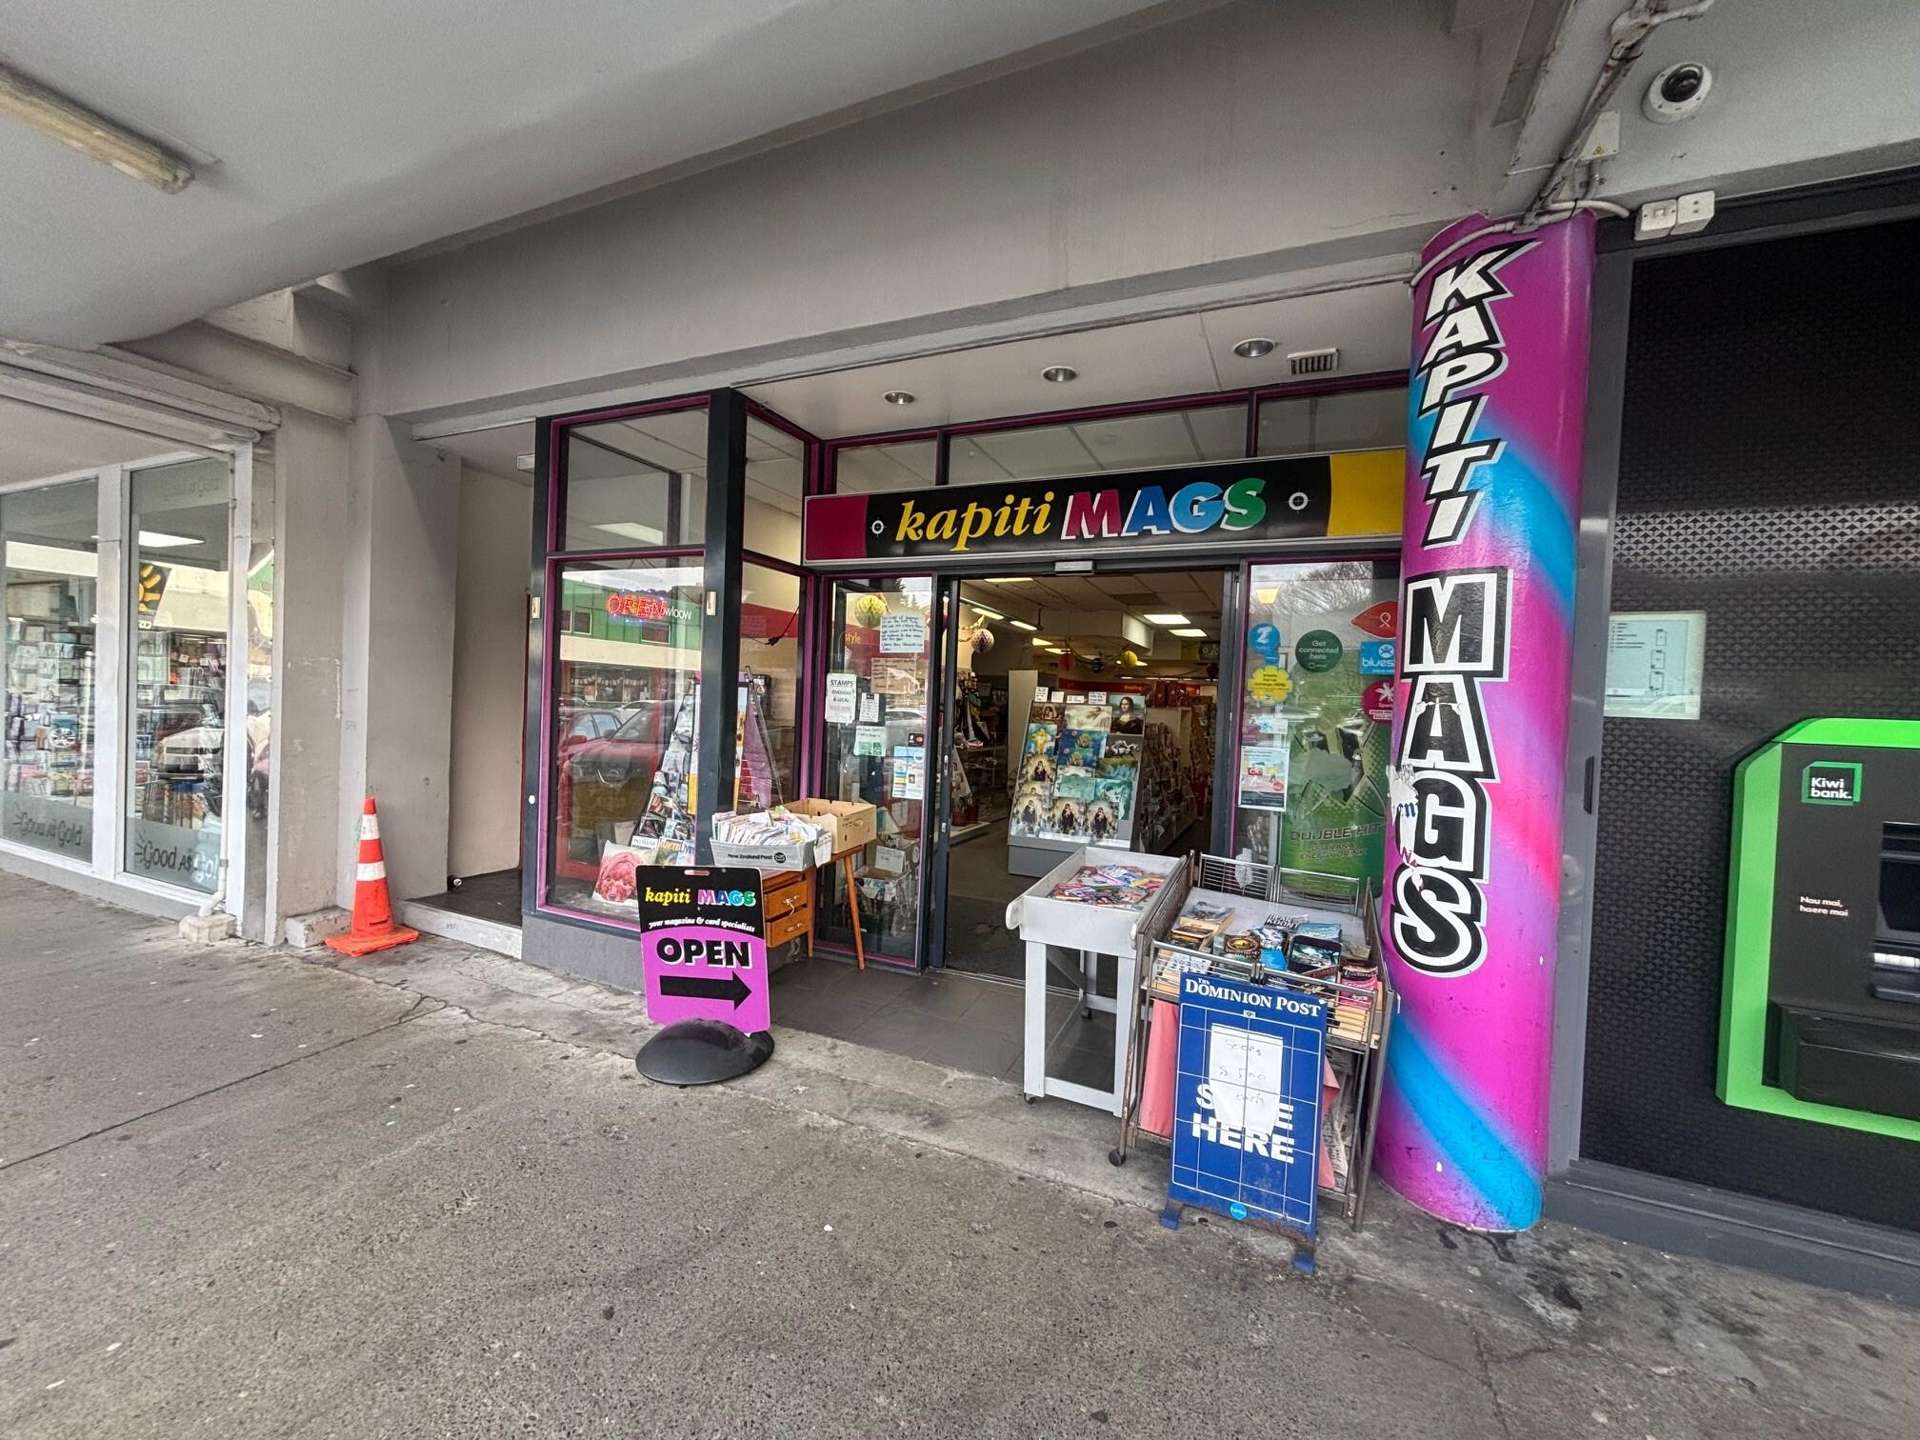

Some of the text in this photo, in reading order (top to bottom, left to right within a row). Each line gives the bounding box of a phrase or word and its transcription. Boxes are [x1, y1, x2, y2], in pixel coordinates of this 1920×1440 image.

[1418, 239, 1542, 549] KAPITI
[895, 478, 1267, 551] kapiti MAGS
[1362, 656, 1394, 667] blues
[1391, 567, 1511, 977] MAGS
[1811, 777, 1845, 789] Kiwi
[1810, 787, 1852, 799] bank.
[143, 840, 177, 871] Good
[645, 887, 756, 907] kapiti MAGS
[1829, 908, 1849, 917] mai
[696, 916, 705, 925] &
[705, 918, 720, 926] card
[721, 921, 756, 933] specialists
[656, 937, 752, 969] OPEN
[1185, 979, 1321, 1018] DOMINION POST
[1195, 1084, 1294, 1131] SE
[1192, 1112, 1295, 1164] HERE
